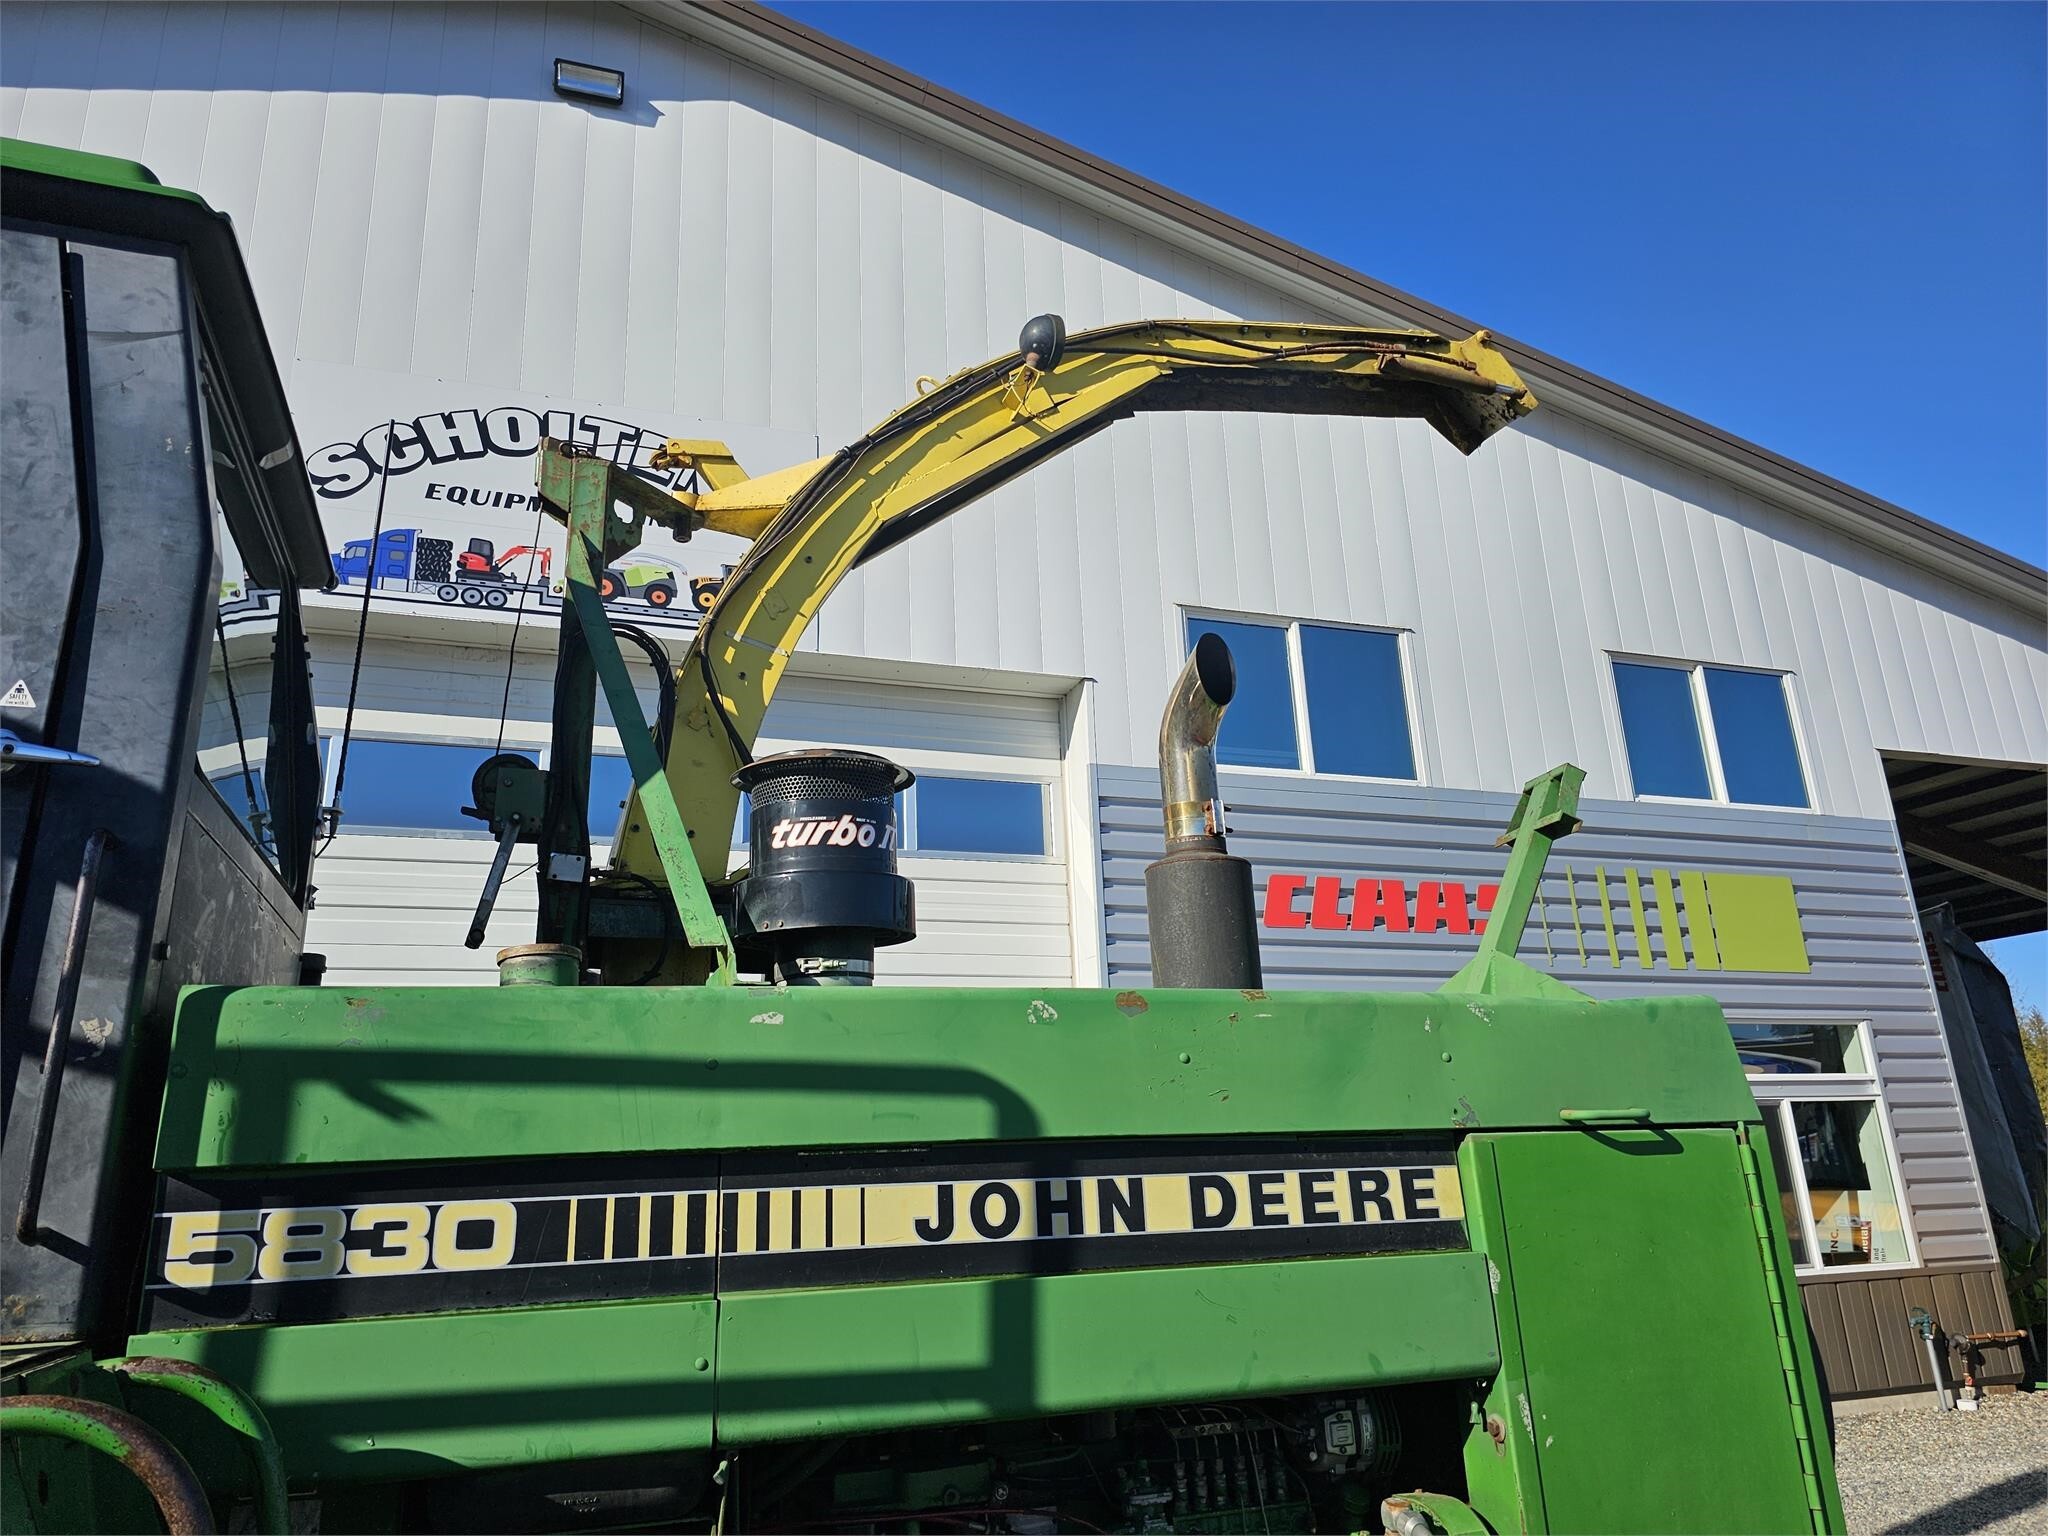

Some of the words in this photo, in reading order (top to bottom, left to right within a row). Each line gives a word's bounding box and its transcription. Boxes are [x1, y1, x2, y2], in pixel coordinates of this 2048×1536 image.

[771, 815, 875, 849] turbo
[914, 1176, 1148, 1243] JOHN
[1191, 1168, 1442, 1230] DEERE
[164, 1200, 518, 1287] 5830
